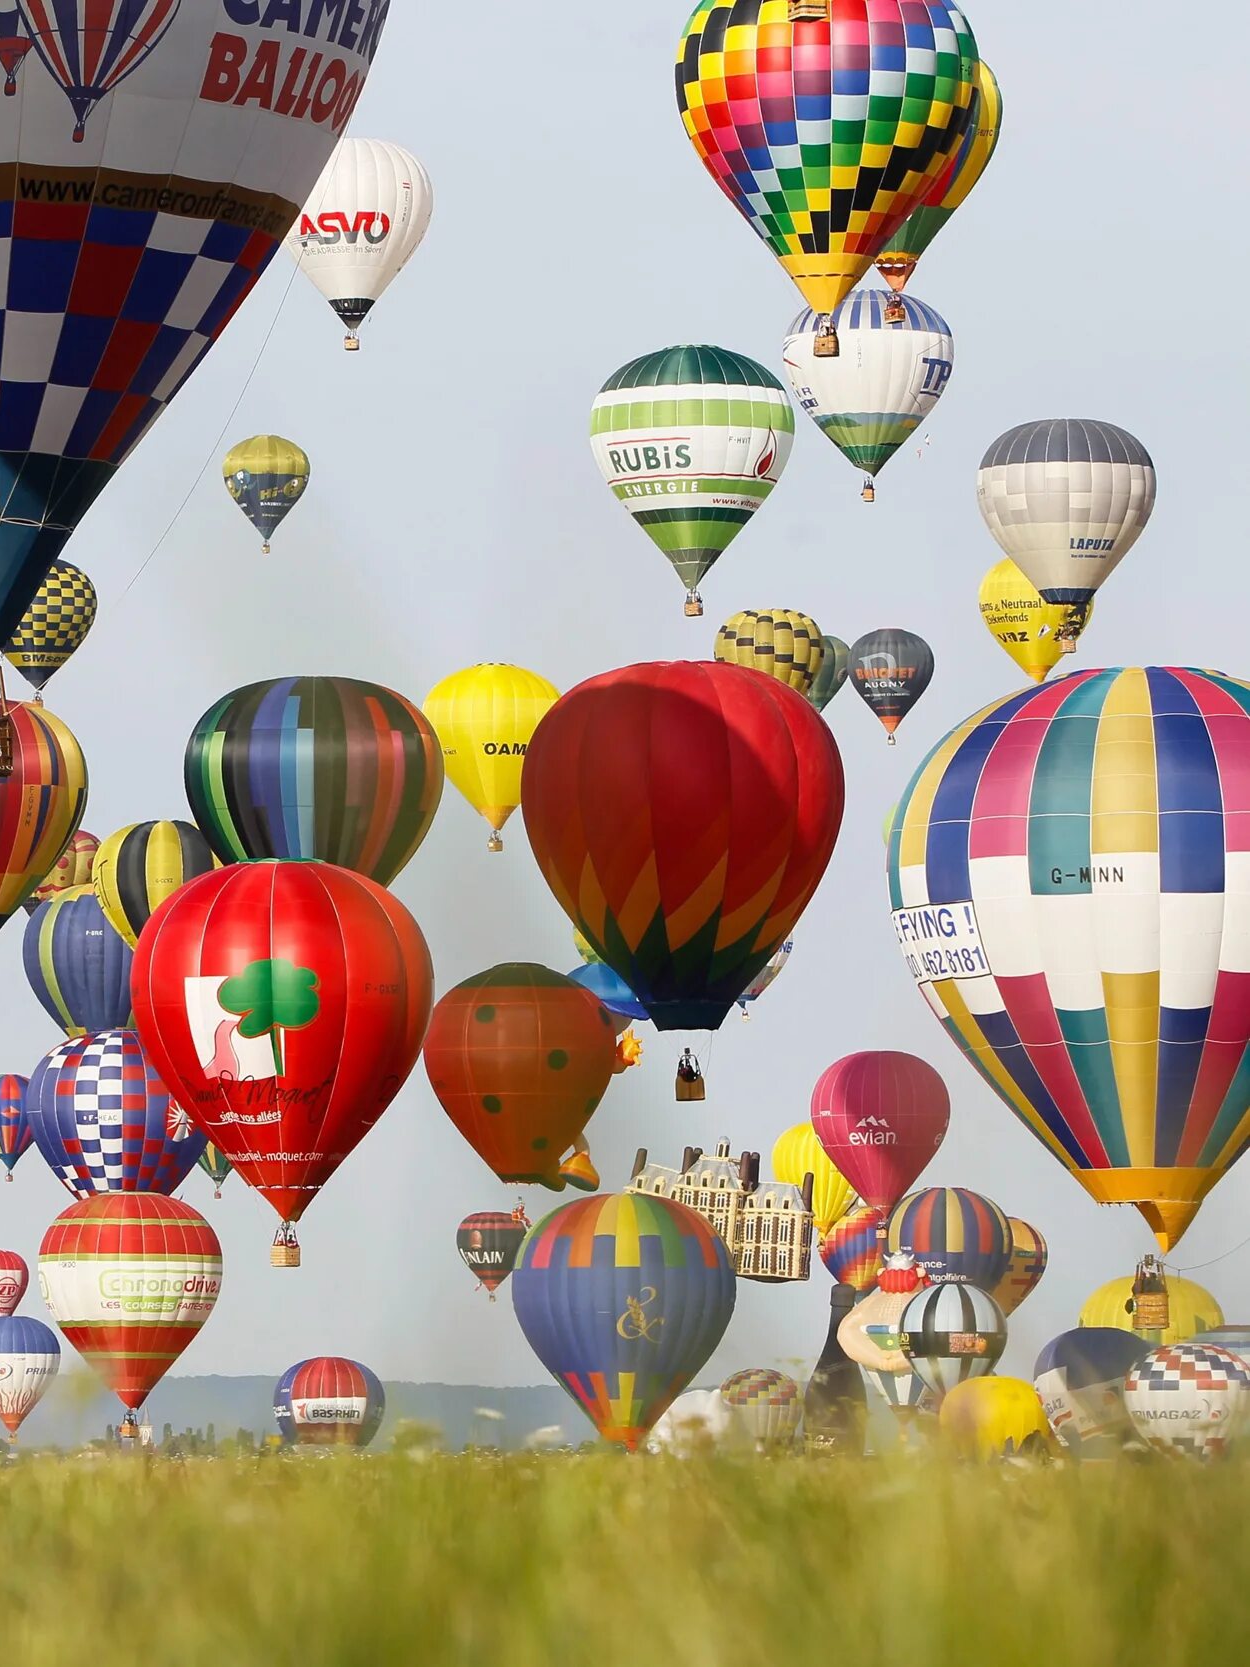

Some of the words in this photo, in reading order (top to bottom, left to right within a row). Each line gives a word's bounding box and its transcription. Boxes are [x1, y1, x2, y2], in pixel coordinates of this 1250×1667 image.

[624, 481, 699, 497] ENERGIE
[1070, 538, 1115, 551] LAPUTA
[1001, 598, 1042, 611] Neutraal
[865, 681, 906, 689] AUGNY
[240, 1113, 255, 1122] vos
[257, 1110, 282, 1122] allées
[101, 1301, 120, 1309] LES
[125, 1301, 174, 1311] COURSES
[177, 1302, 202, 1311] FAITES
